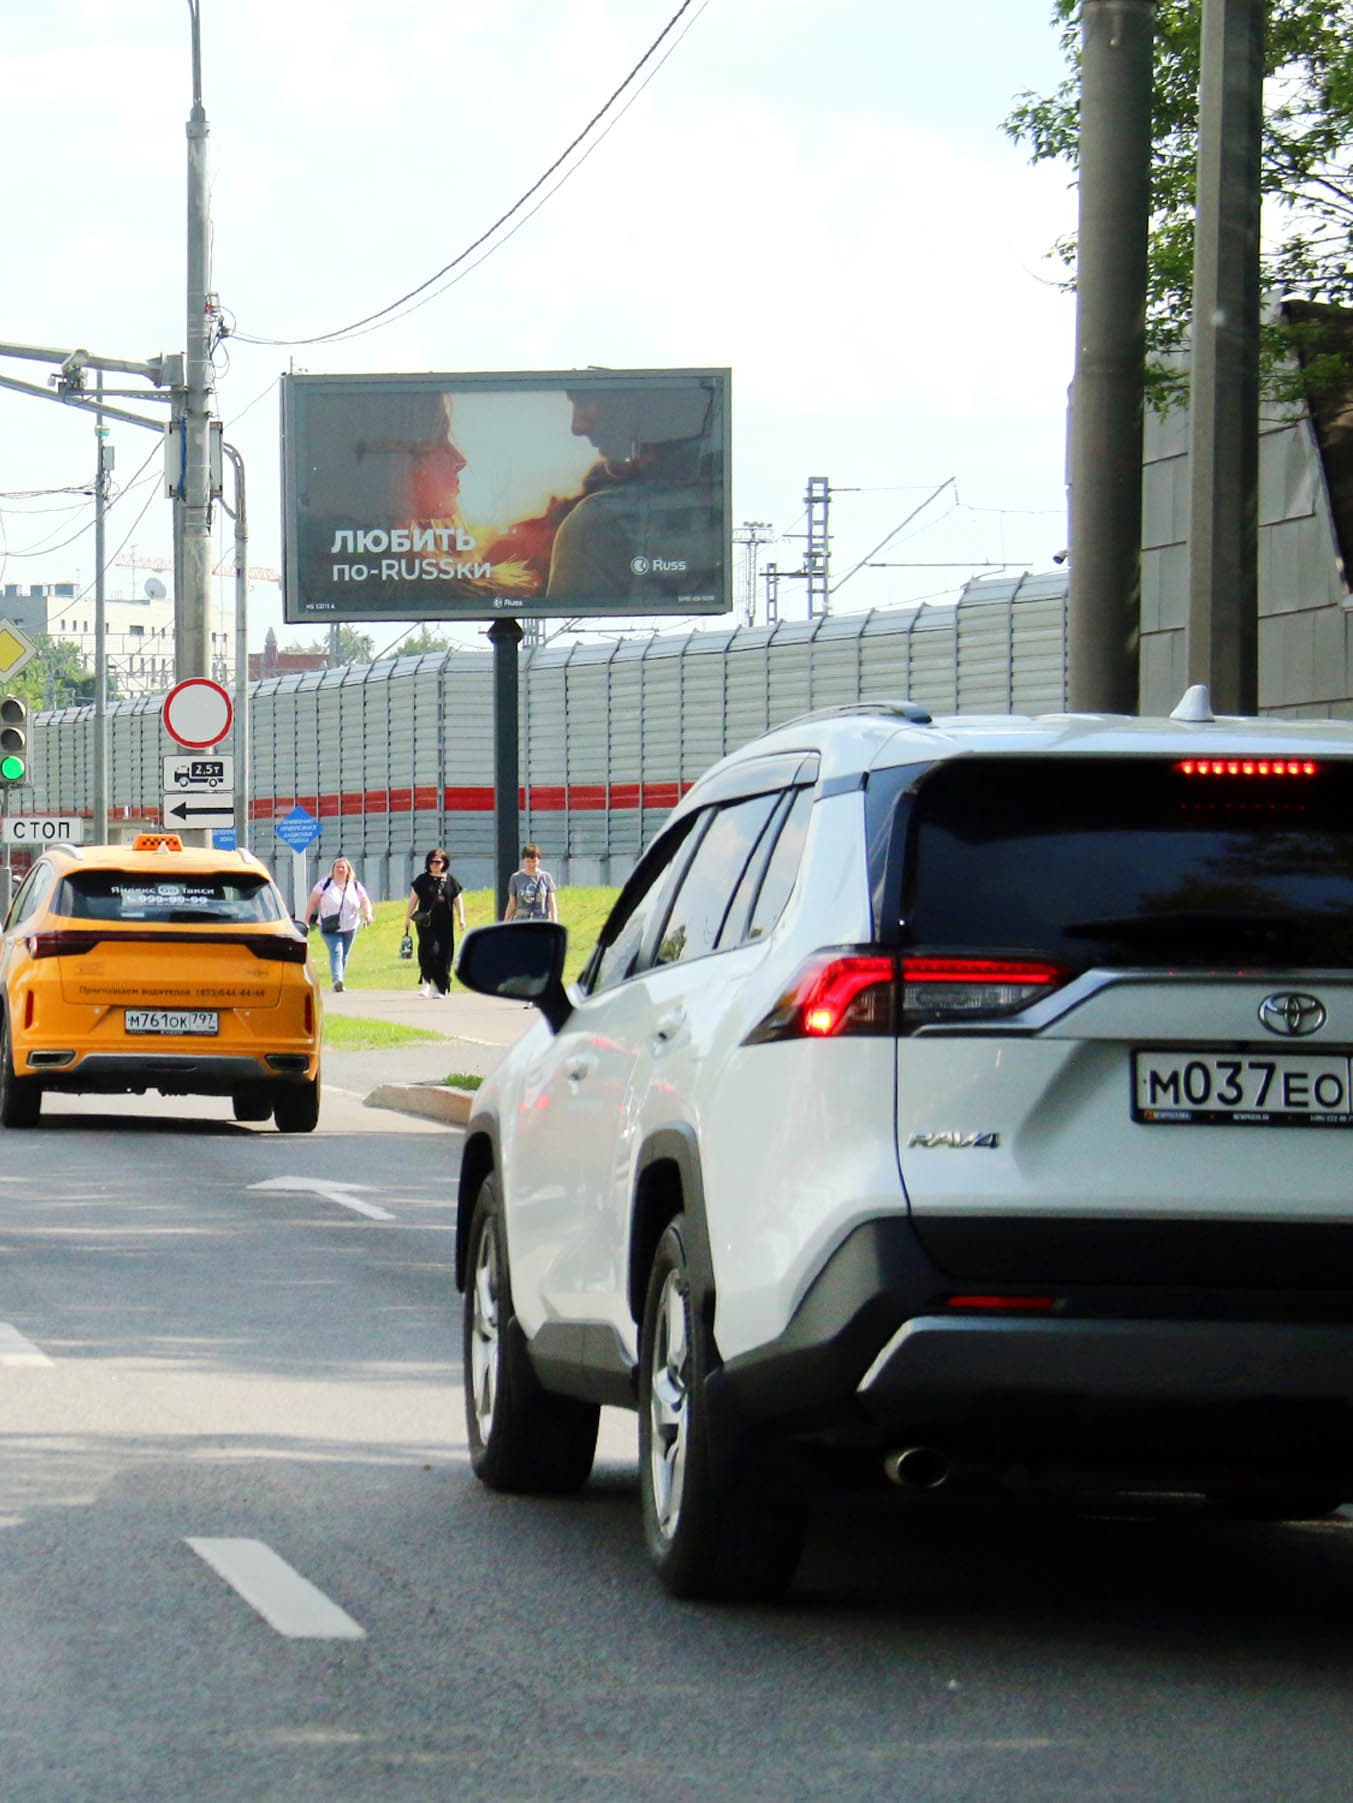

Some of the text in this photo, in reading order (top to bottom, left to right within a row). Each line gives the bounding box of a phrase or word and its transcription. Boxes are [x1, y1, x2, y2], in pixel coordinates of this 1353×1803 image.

[331, 528, 477, 553] ЛЮБИТЬ
[653, 559, 687, 571] Russ
[13, 822, 70, 839] СТОП
[111, 886, 156, 895] Яндекс
[182, 887, 215, 895] Такси
[140, 895, 208, 904] 999-99-99
[129, 1013, 214, 1029] М761ОК 797
[1149, 1061, 1345, 1108] М037ЕО
